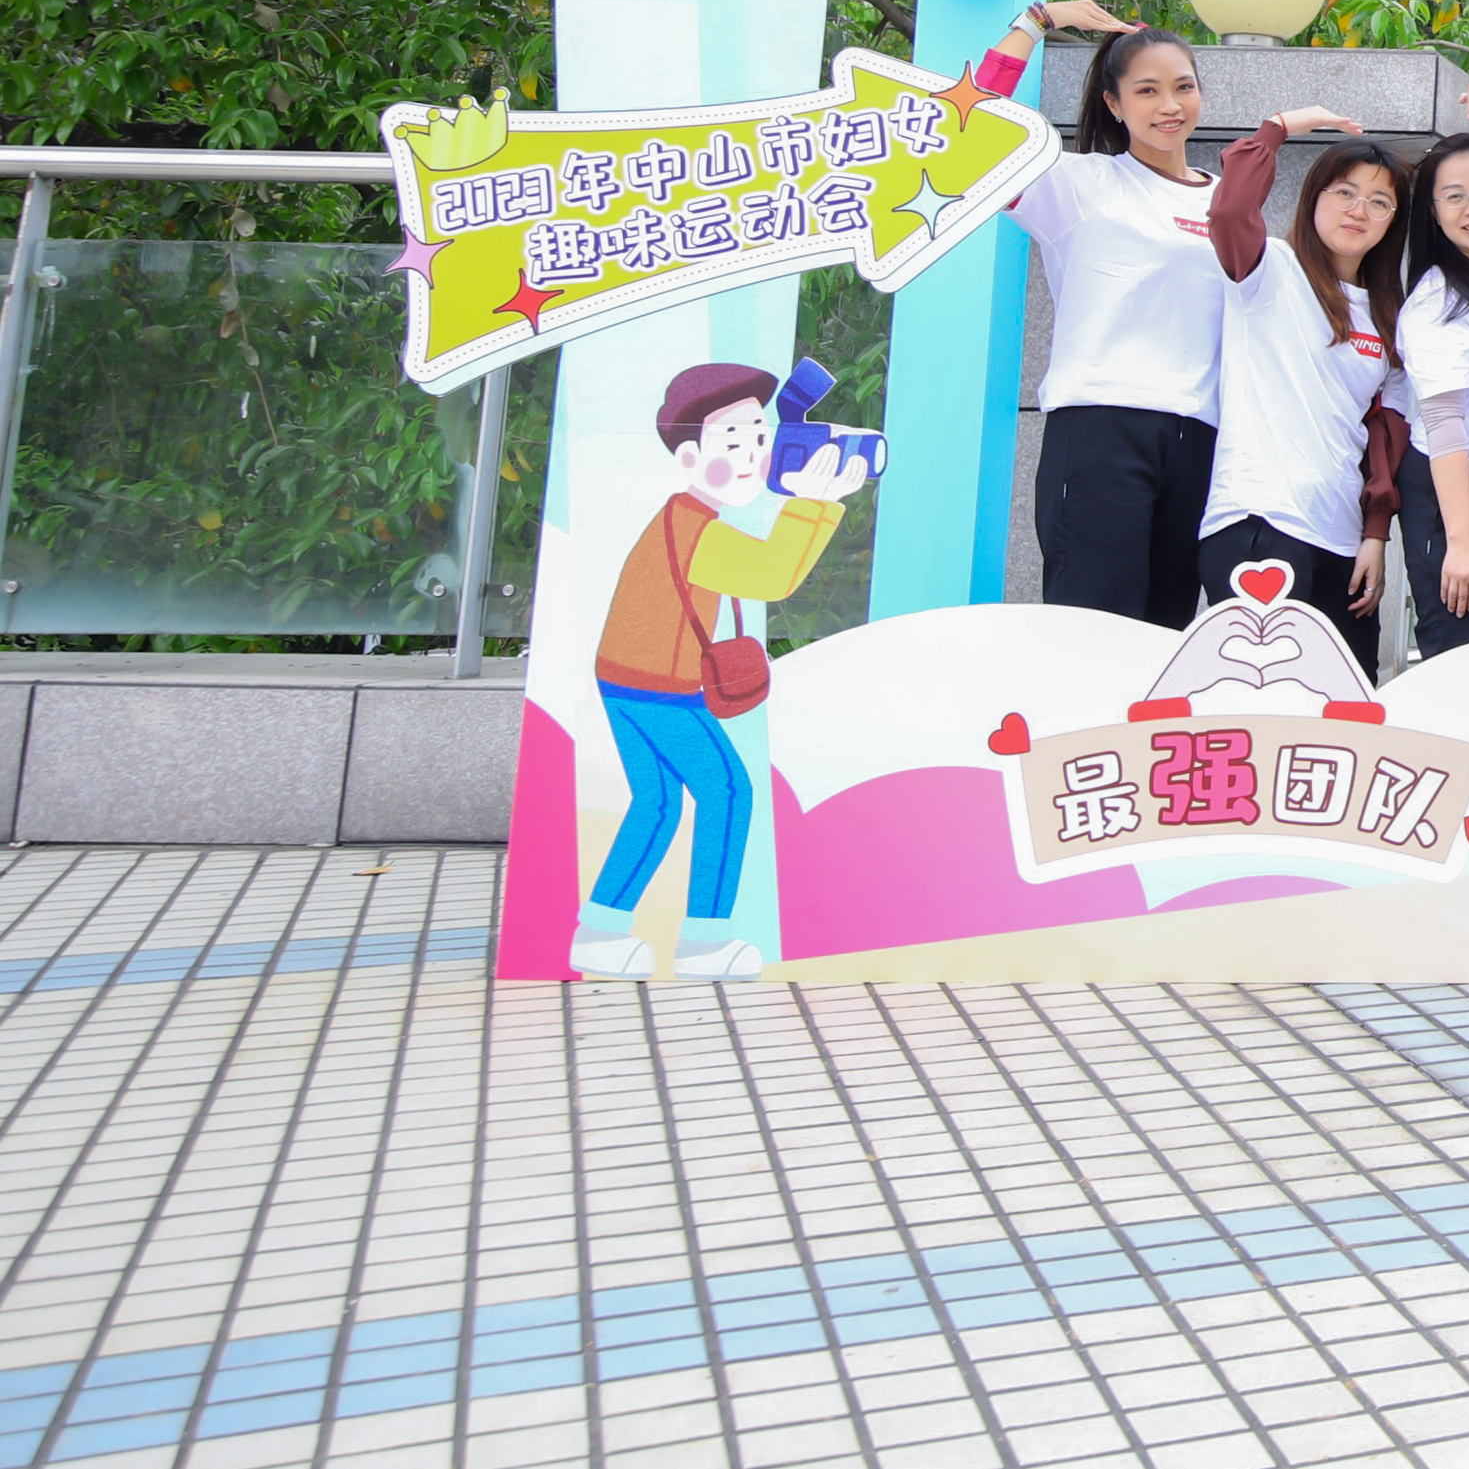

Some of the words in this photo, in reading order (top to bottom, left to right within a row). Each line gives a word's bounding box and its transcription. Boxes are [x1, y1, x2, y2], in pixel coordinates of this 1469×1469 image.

[529, 175, 872, 284] 趣味运动会
[1054, 728, 1449, 848] 最强团队
